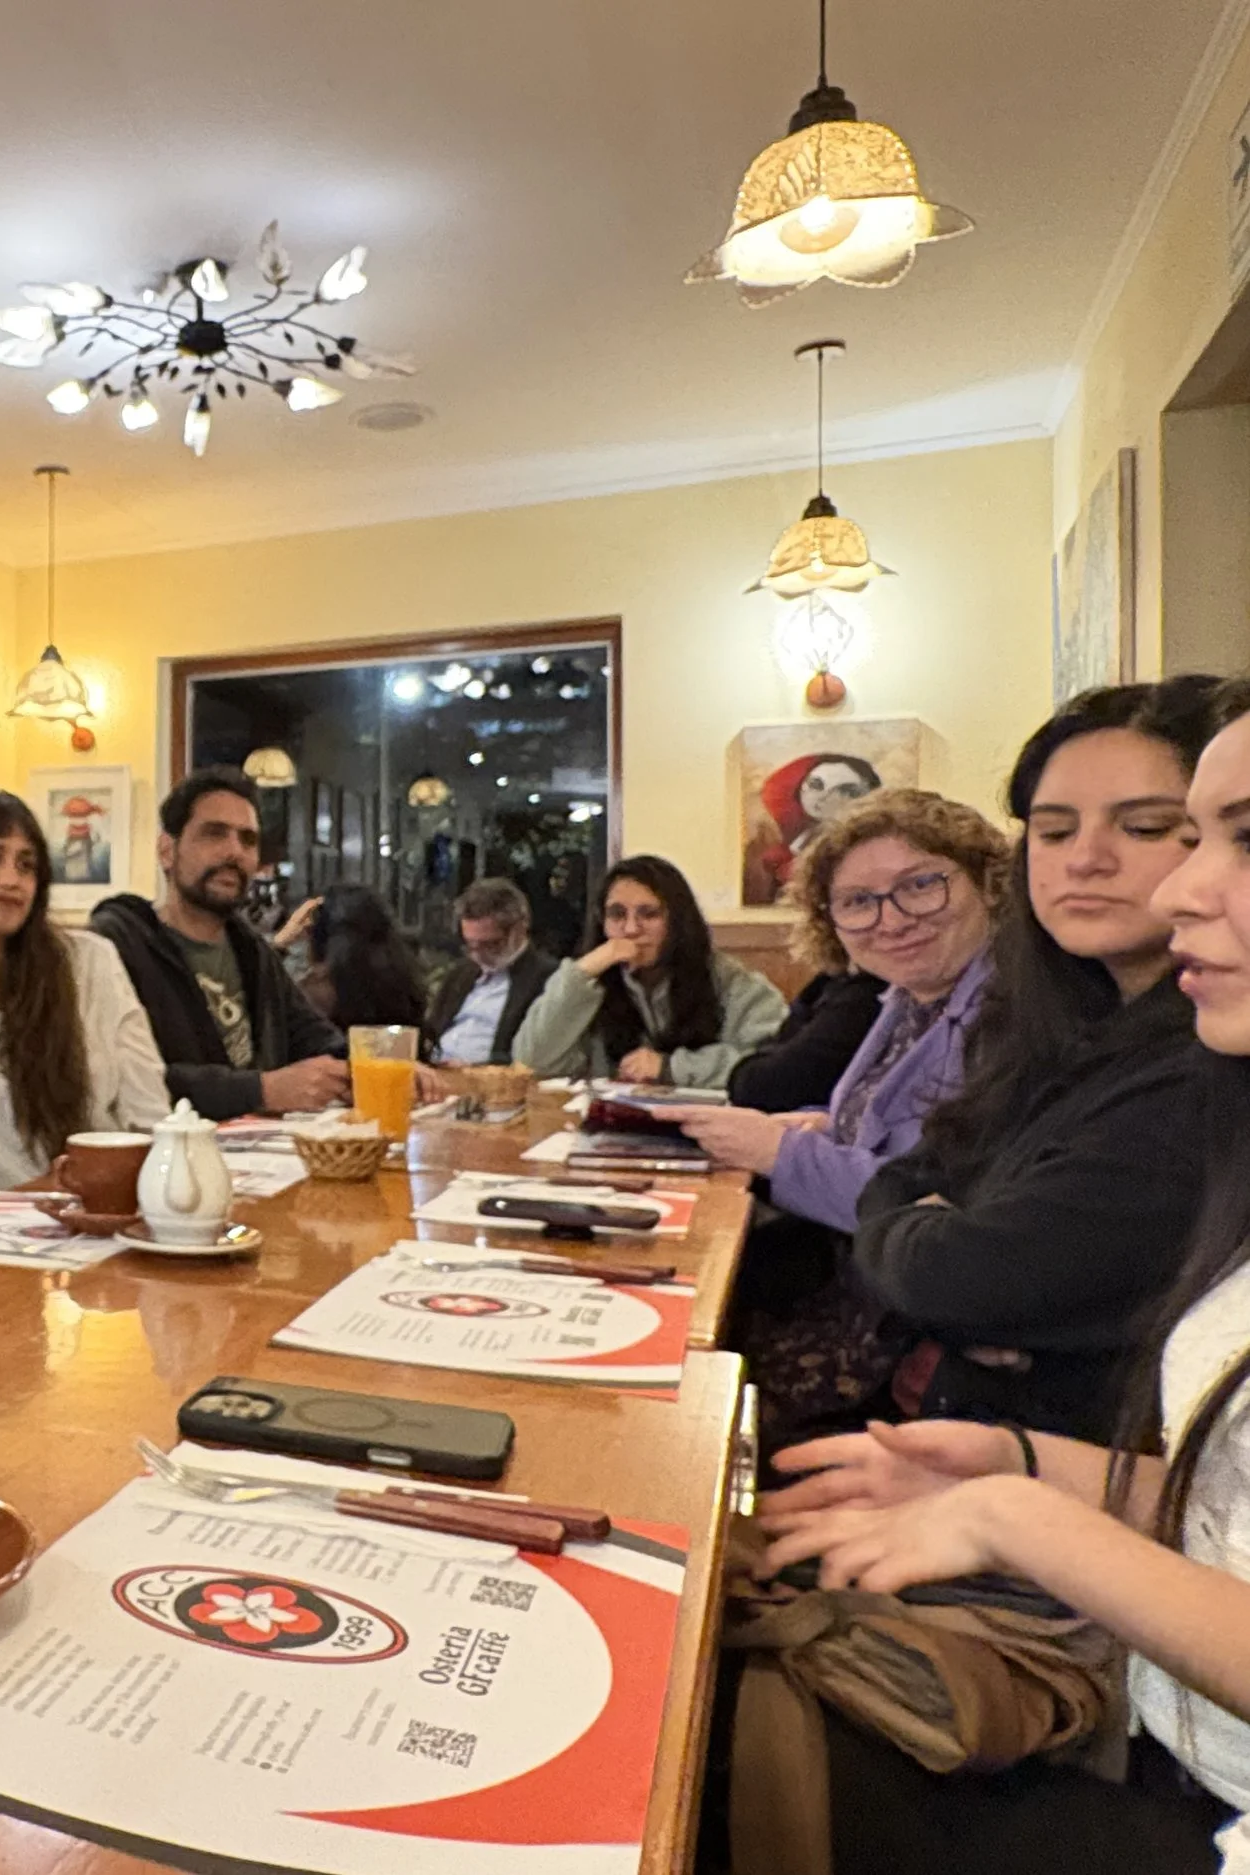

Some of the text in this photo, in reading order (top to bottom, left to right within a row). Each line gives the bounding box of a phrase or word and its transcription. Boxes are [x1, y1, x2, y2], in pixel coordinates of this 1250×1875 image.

[136, 1571, 194, 1619] ACC
[330, 1615, 374, 1651] 1999
[418, 1626, 472, 1684] Osteria
